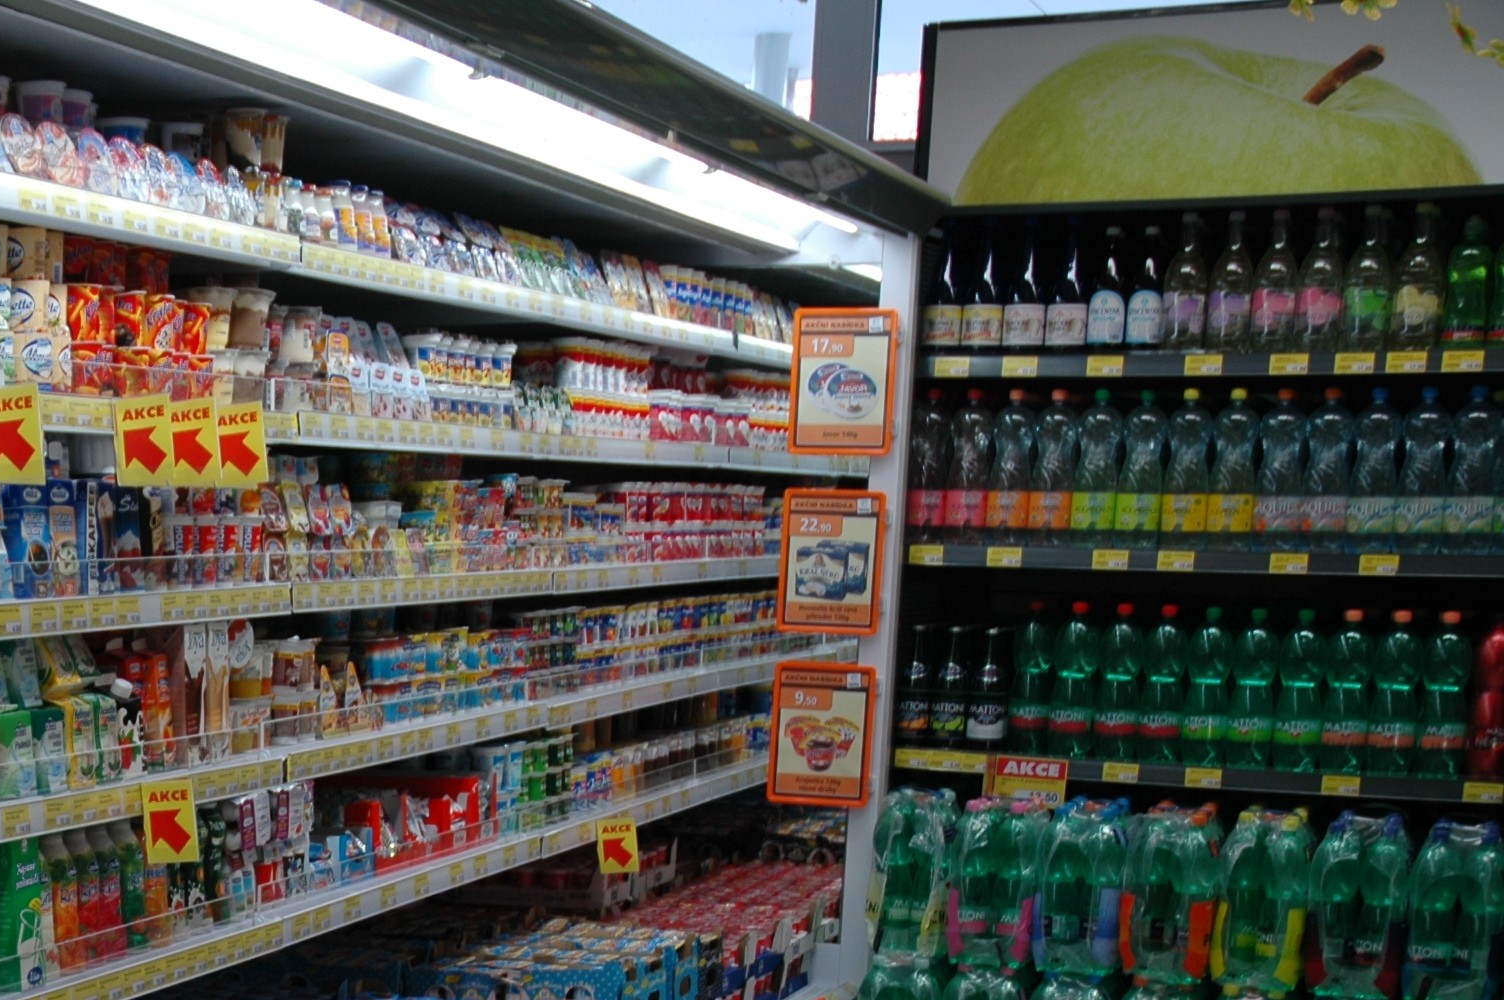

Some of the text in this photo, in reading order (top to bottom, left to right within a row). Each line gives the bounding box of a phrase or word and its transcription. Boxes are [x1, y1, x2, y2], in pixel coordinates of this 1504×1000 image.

[810, 337, 844, 355] 17,90
[122, 405, 165, 422] AKCE
[170, 407, 210, 423] AKCE
[218, 410, 258, 427] AKCE
[799, 516, 832, 534] 22,90
[794, 689, 818, 706] 9,50
[1003, 759, 1061, 777] AKCE
[147, 788, 189, 803] AKCE
[601, 824, 632, 836] AKCE
